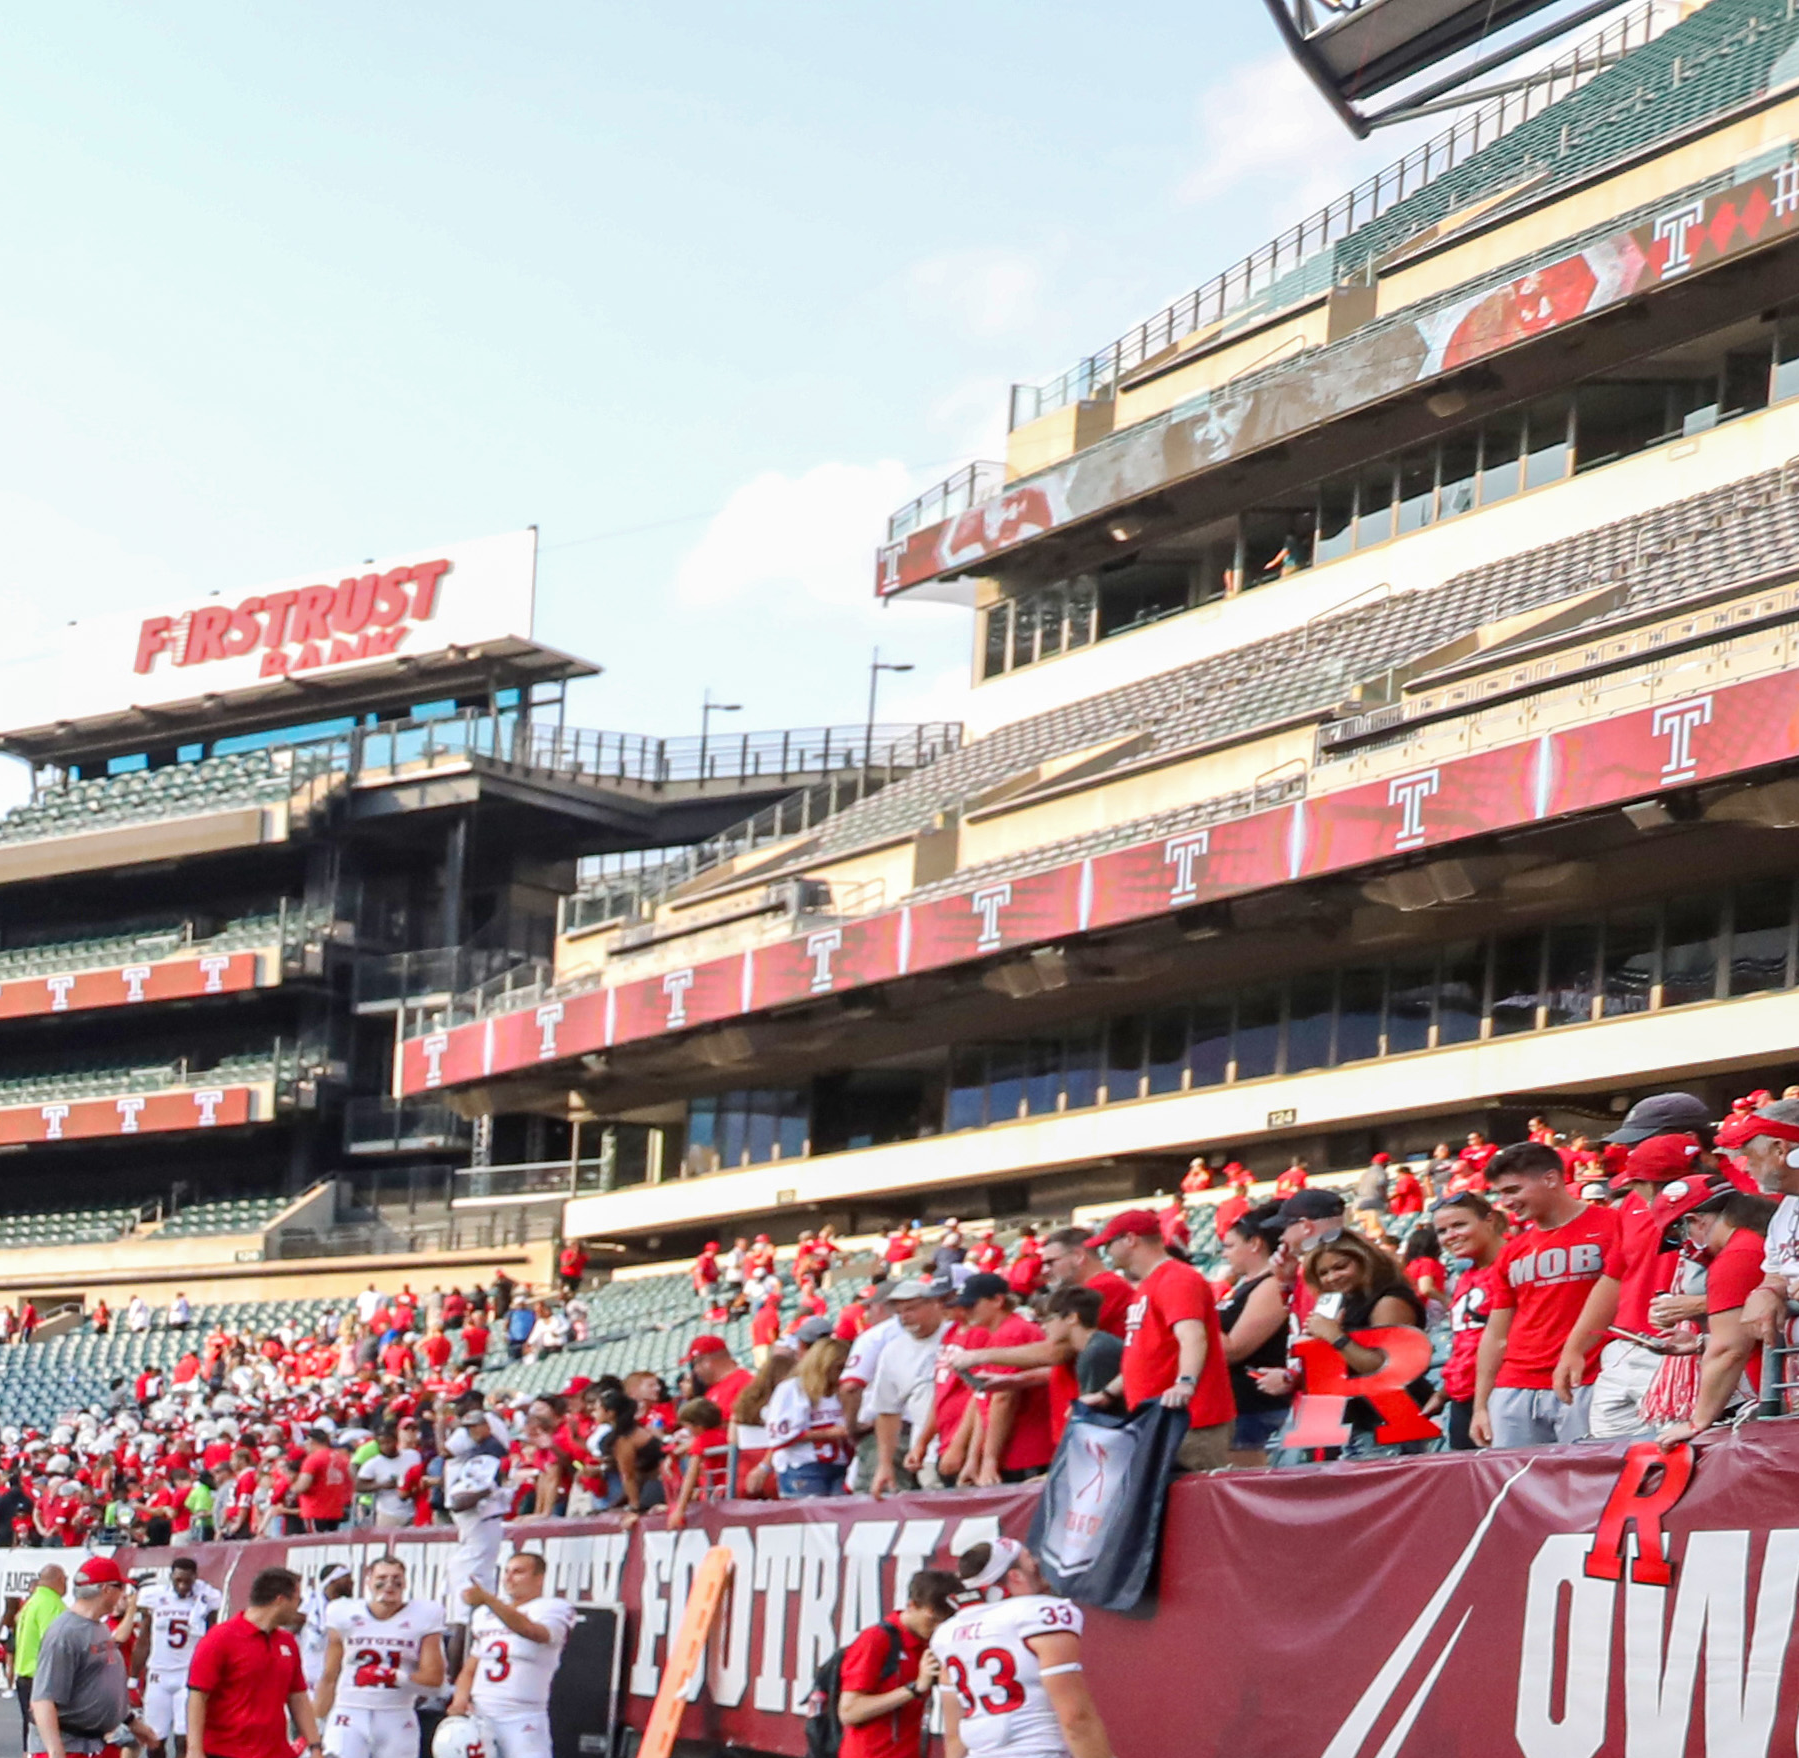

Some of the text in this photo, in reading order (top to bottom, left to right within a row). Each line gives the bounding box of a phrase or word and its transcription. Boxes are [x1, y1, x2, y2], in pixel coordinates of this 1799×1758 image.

[134, 558, 454, 675] FIRSTRUST
[258, 626, 412, 679] BANK
[1510, 1244, 1602, 1287] MOB
[1282, 1326, 1441, 1447] R
[1584, 1441, 1693, 1586] R
[168, 1619, 188, 1649] 5
[630, 1516, 1000, 1735] FOOTBA
[1039, 1605, 1072, 1625] 33
[347, 1636, 415, 1648] RUTGERS
[485, 1641, 511, 1683] 3
[335, 1714, 350, 1726] R
